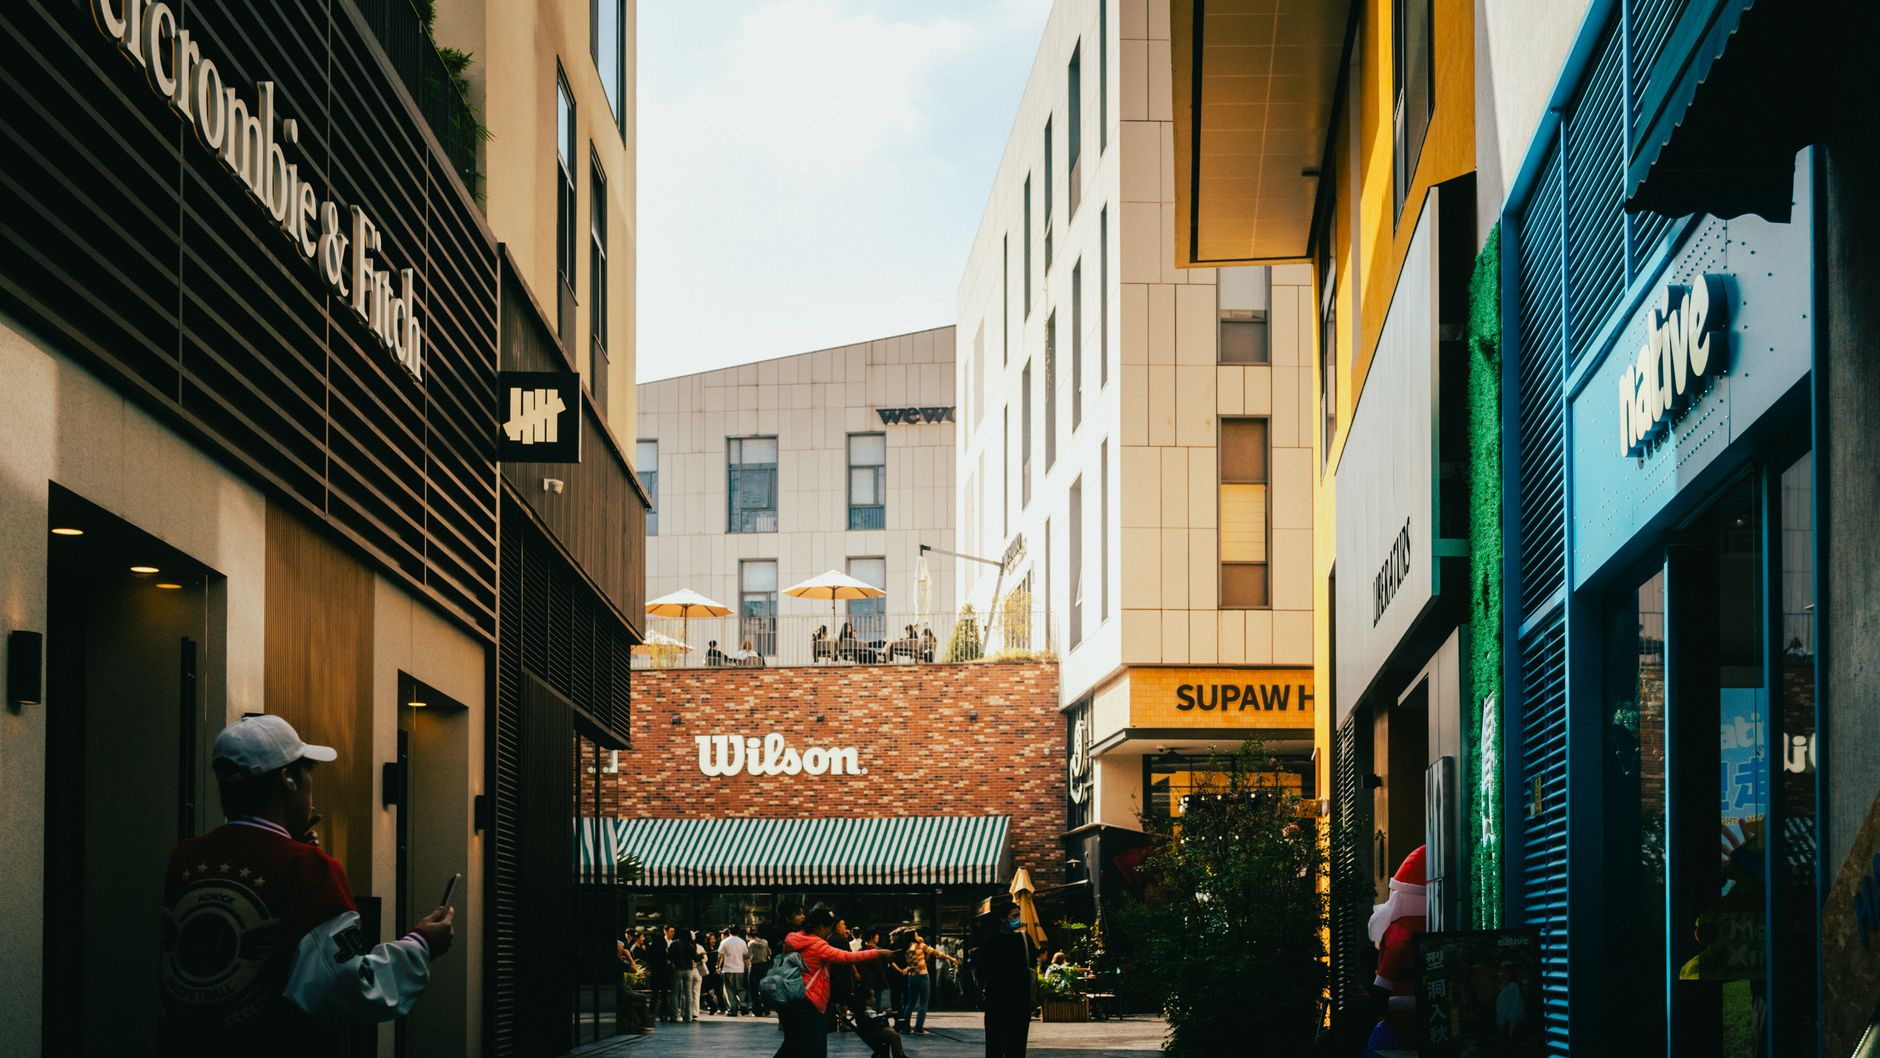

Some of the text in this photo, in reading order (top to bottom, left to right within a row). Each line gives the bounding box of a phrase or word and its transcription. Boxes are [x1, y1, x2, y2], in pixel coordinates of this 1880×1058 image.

[319, 201, 349, 297] &
[350, 205, 422, 382] Fitch
[1619, 274, 1711, 458] native
[1176, 684, 1290, 711] SUPAW
